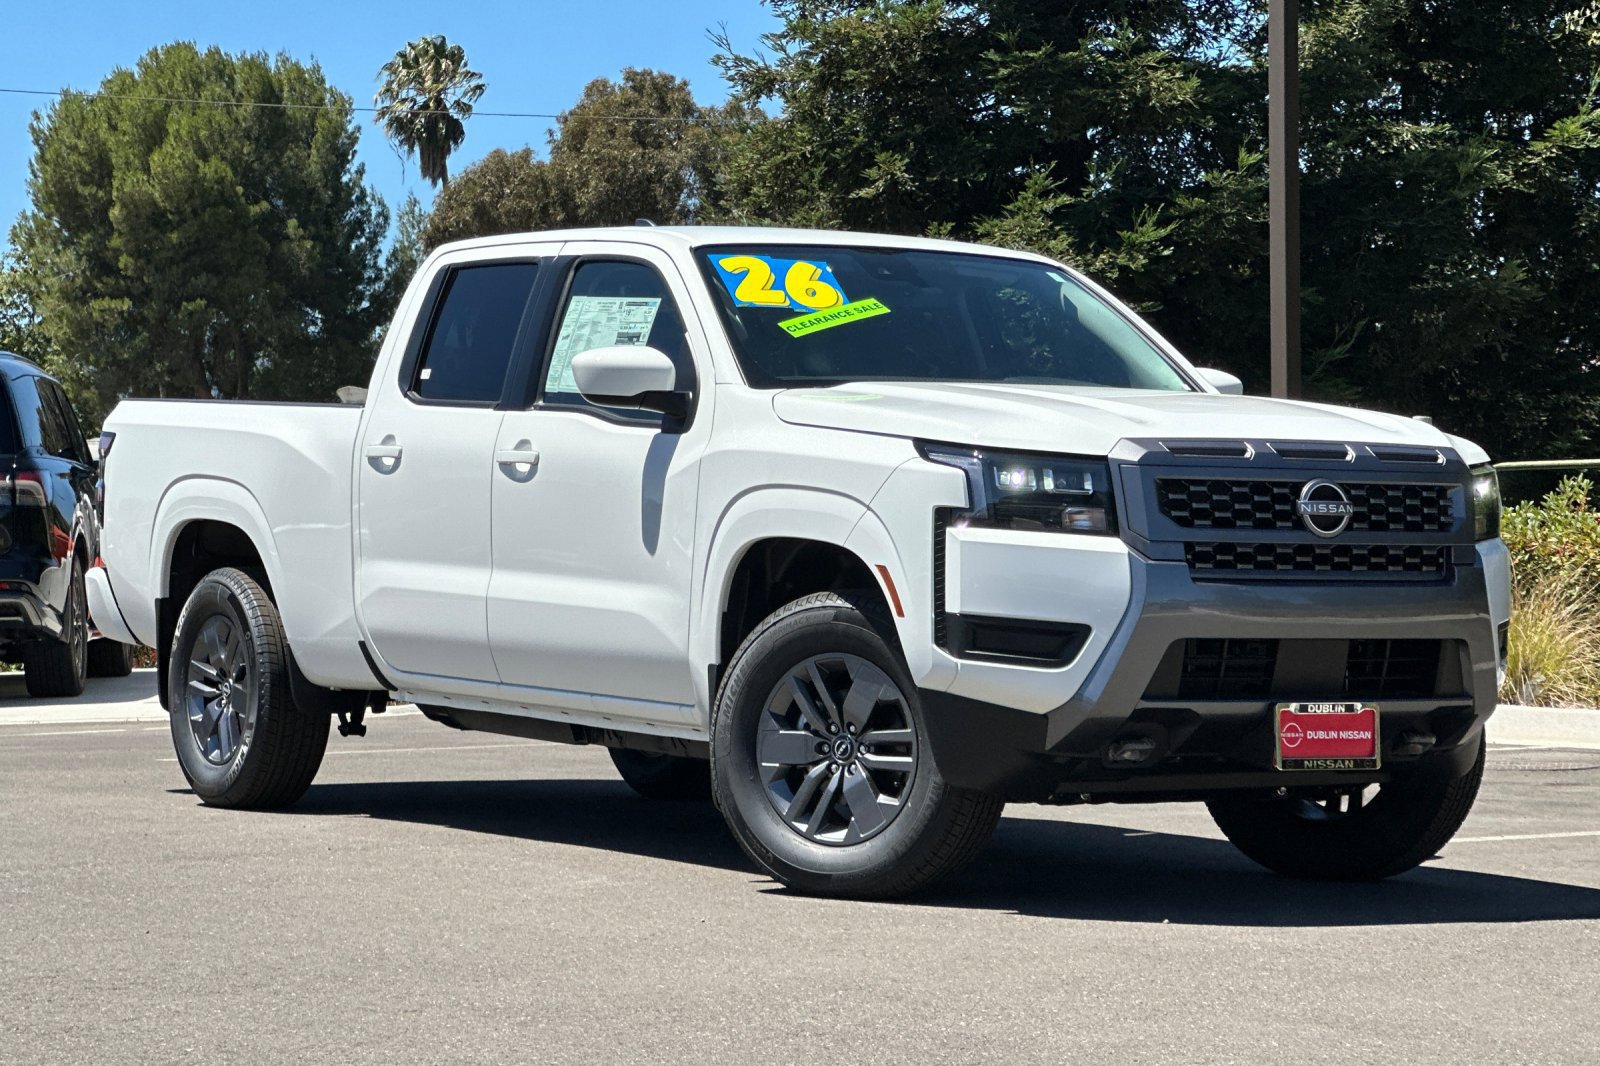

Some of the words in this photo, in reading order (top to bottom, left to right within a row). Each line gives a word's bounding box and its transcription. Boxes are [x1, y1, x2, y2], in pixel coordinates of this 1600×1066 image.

[718, 255, 844, 309] 26
[786, 308, 853, 333] CLEARANCE
[854, 301, 885, 318] SALE
[1301, 504, 1353, 513] NISSAN
[1307, 704, 1345, 713] DUBLIN
[1306, 730, 1338, 739] DUBLIN
[1339, 730, 1371, 739] NISSAN
[1304, 759, 1354, 769] NISSAN
